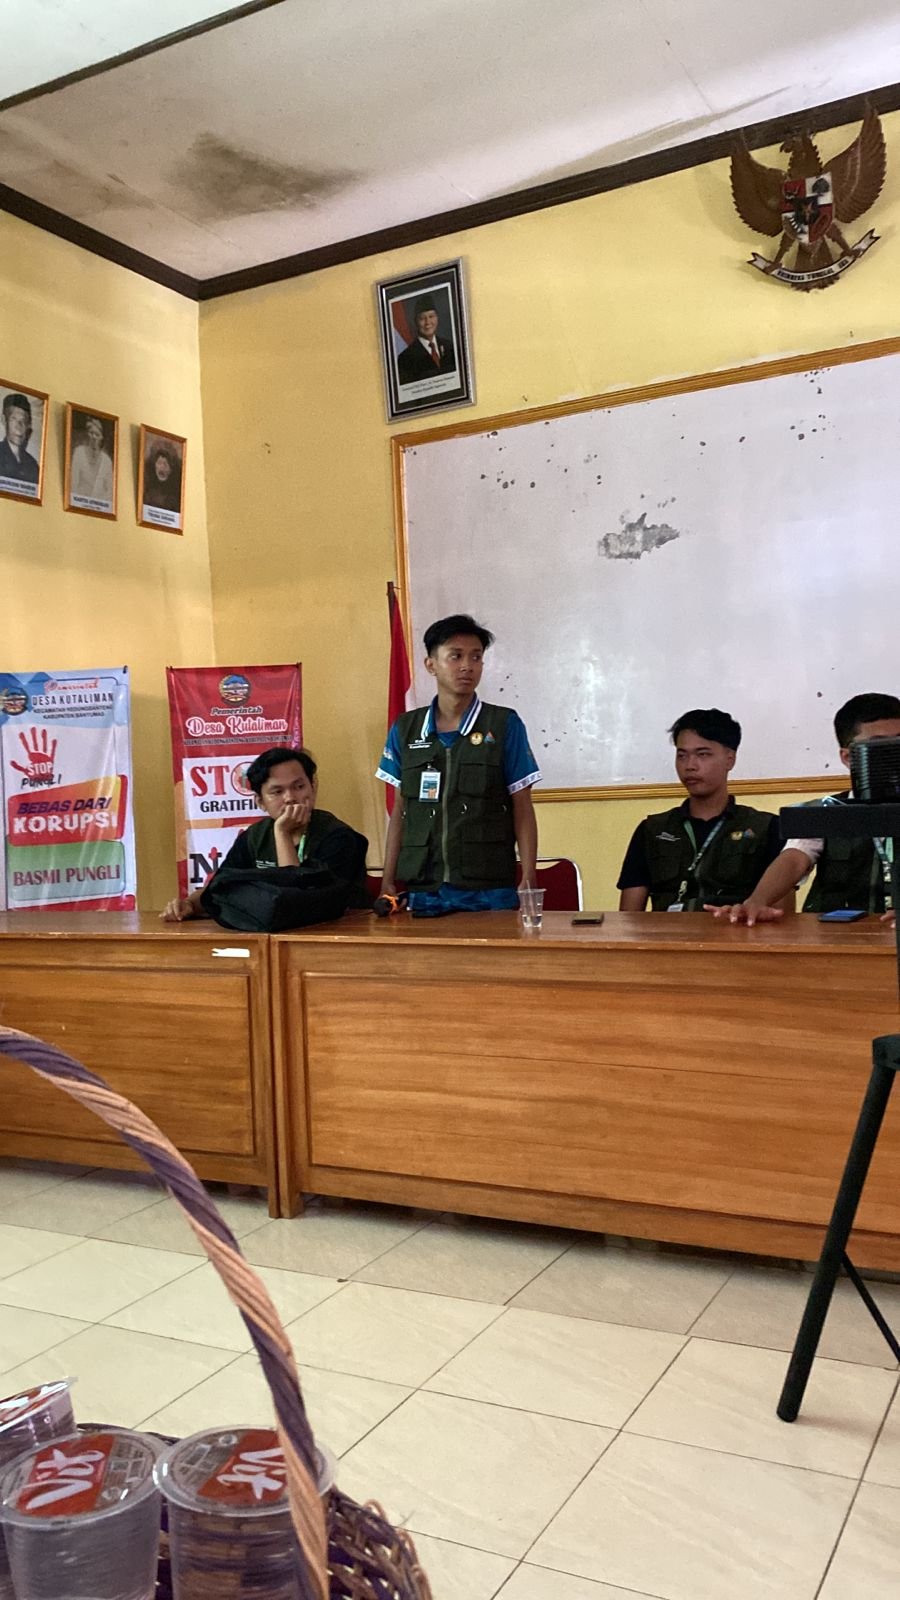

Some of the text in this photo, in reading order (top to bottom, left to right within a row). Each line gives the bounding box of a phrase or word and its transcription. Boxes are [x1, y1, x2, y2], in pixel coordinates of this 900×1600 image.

[32, 695, 57, 706] DESA
[211, 705, 263, 716] Pemerintah
[186, 717, 225, 737] Desa
[28, 761, 53, 776] STOP
[17, 797, 113, 815] BEBAS DARI
[13, 811, 118, 834] KORUPSI
[13, 864, 121, 886] BASMI PUNGLI
